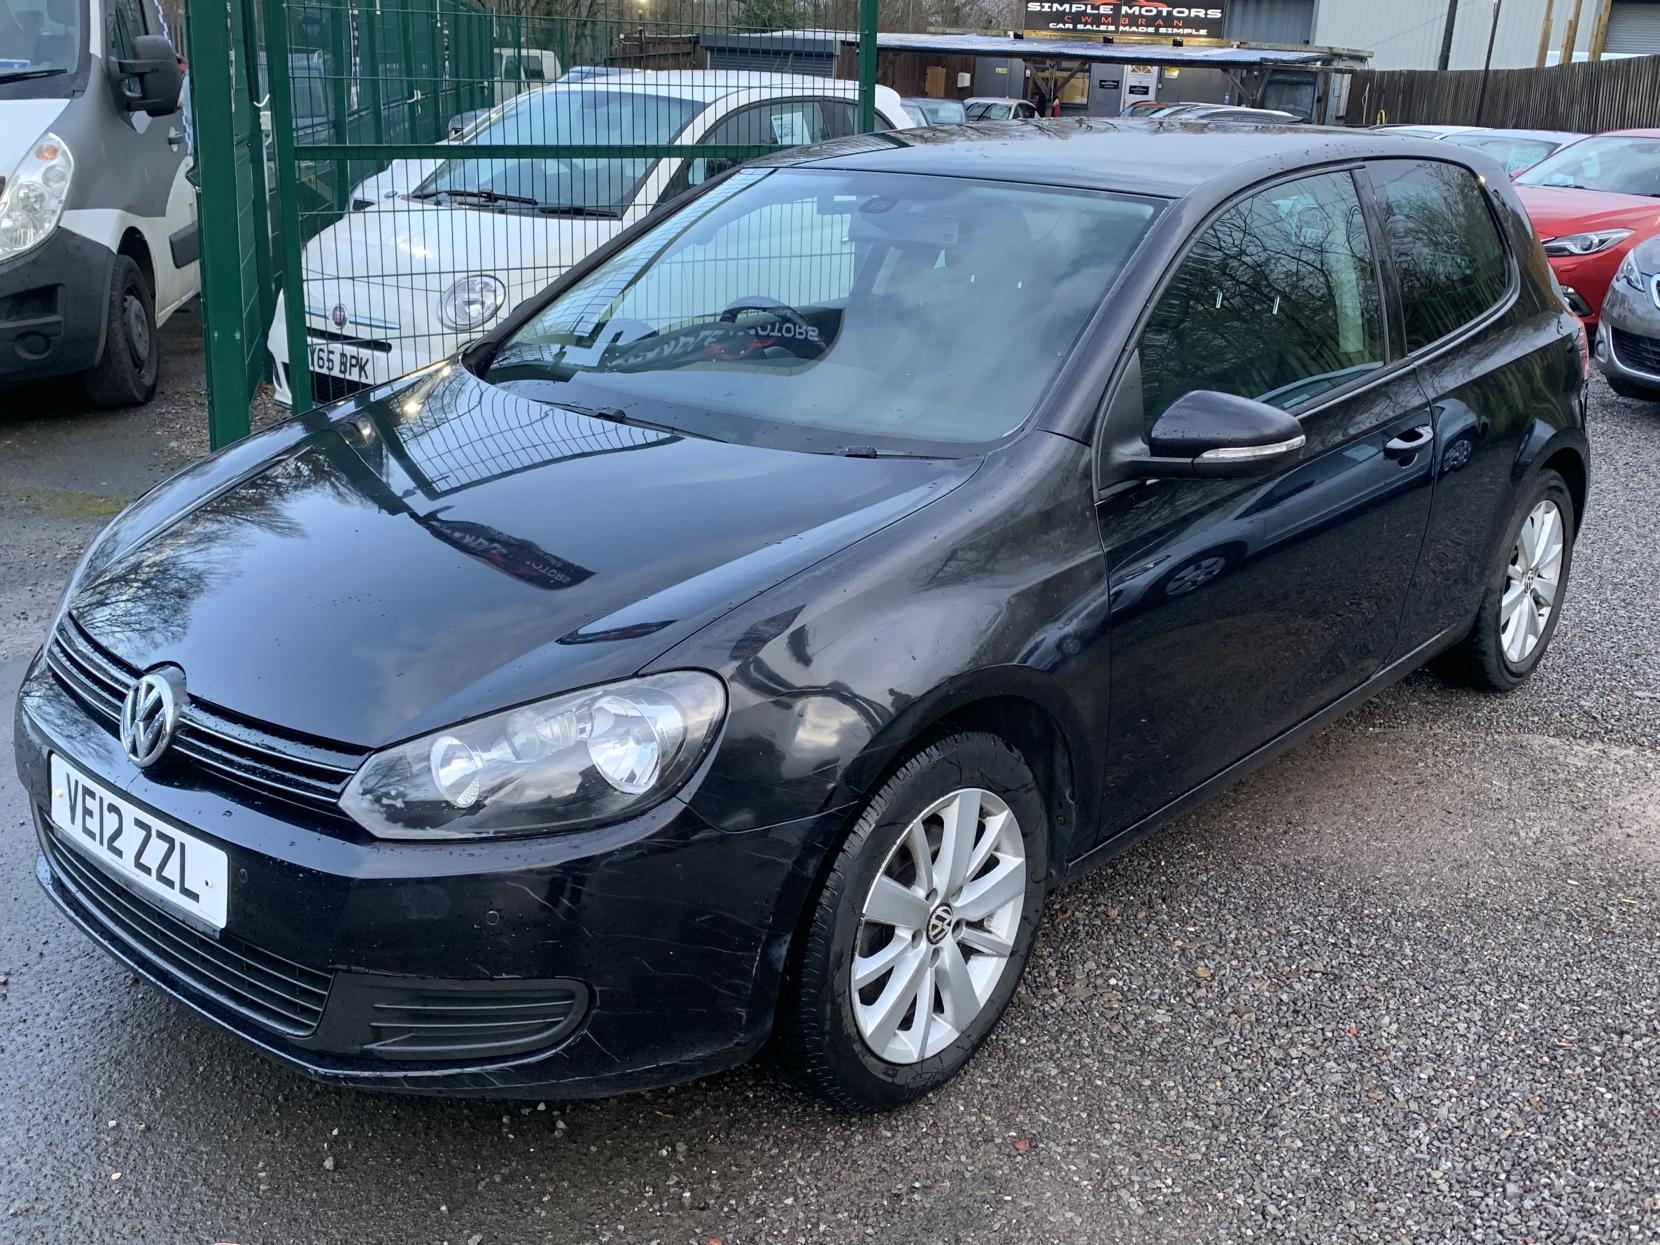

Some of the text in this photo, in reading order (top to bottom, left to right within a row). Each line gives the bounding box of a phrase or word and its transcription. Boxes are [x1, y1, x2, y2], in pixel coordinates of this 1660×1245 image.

[1027, 2, 1222, 18] SIMPLE MOTORS
[1064, 15, 1183, 27] CWMBRAN
[1119, 25, 1155, 33] MADE
[1158, 27, 1208, 35] SIMPLE
[339, 352, 369, 379] BPK
[66, 773, 200, 904] VE12 ZZL
